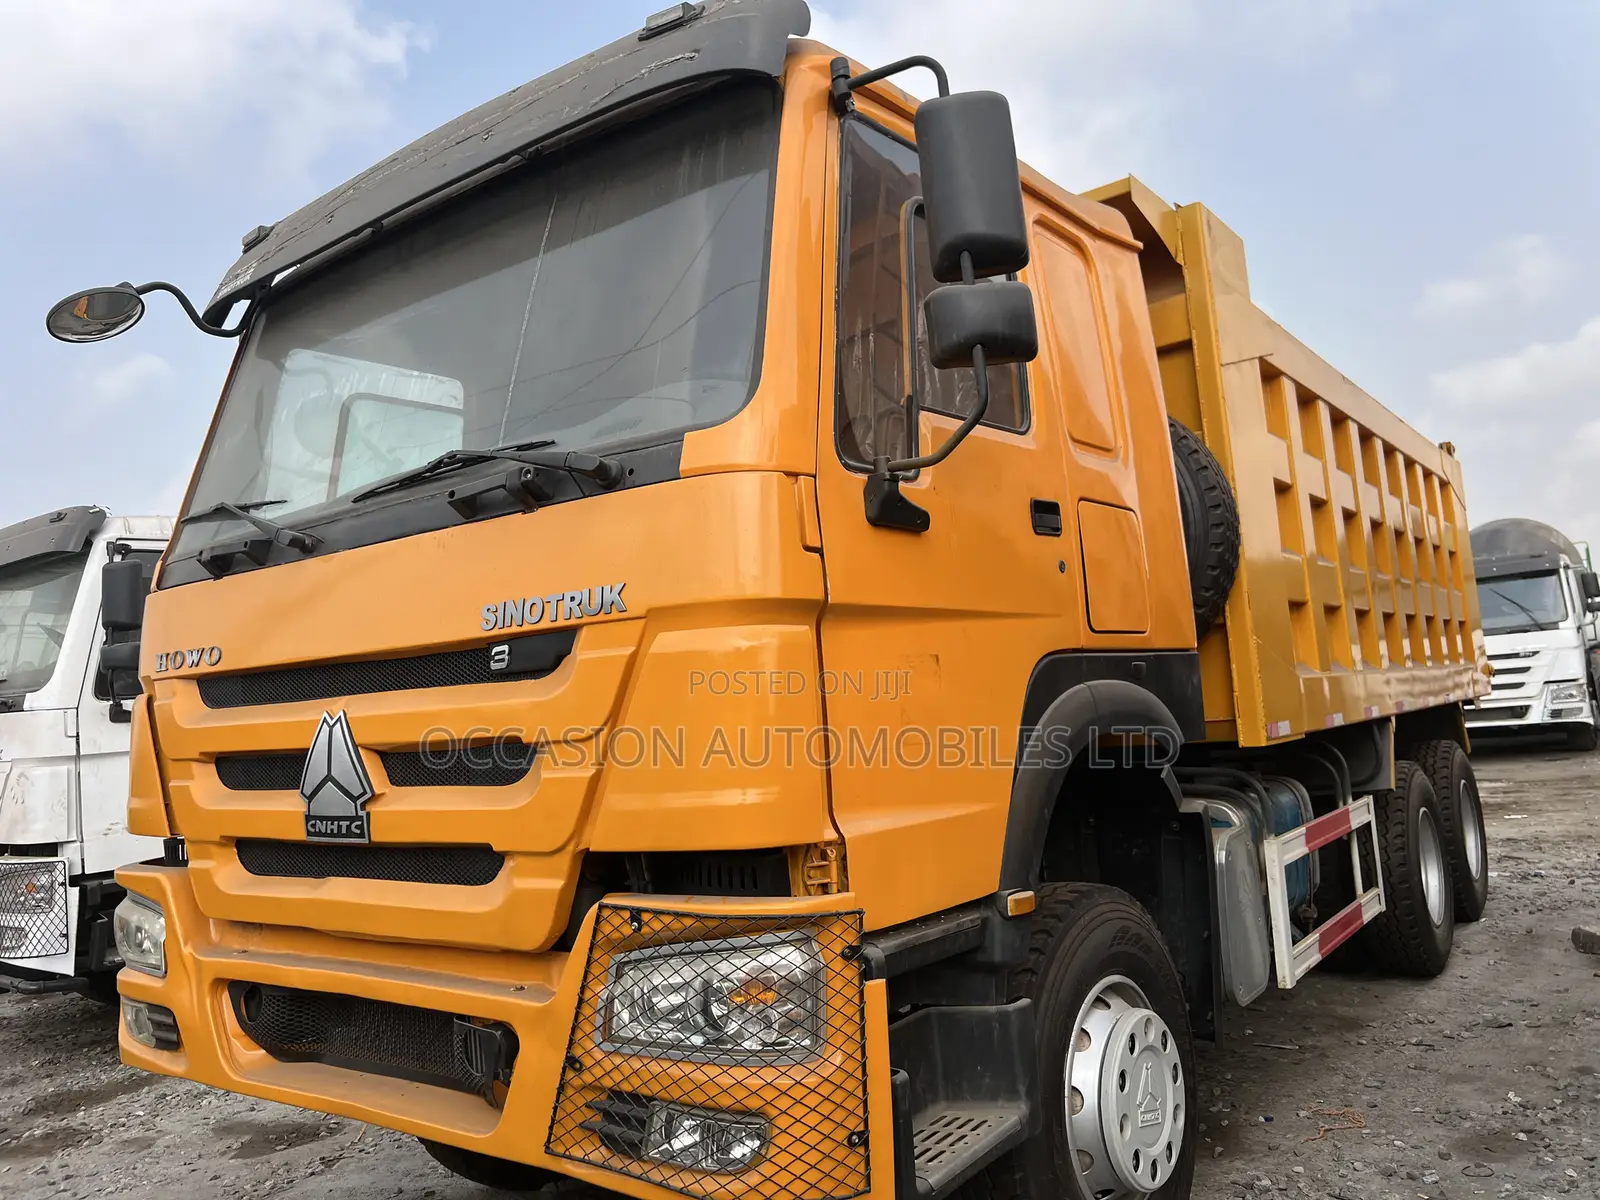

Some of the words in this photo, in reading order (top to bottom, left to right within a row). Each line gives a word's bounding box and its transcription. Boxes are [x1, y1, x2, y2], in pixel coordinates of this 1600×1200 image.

[480, 582, 627, 631] SINOTRUK
[155, 646, 222, 672] HOWO
[490, 644, 510, 671] 3
[307, 820, 362, 834] CNHTC
